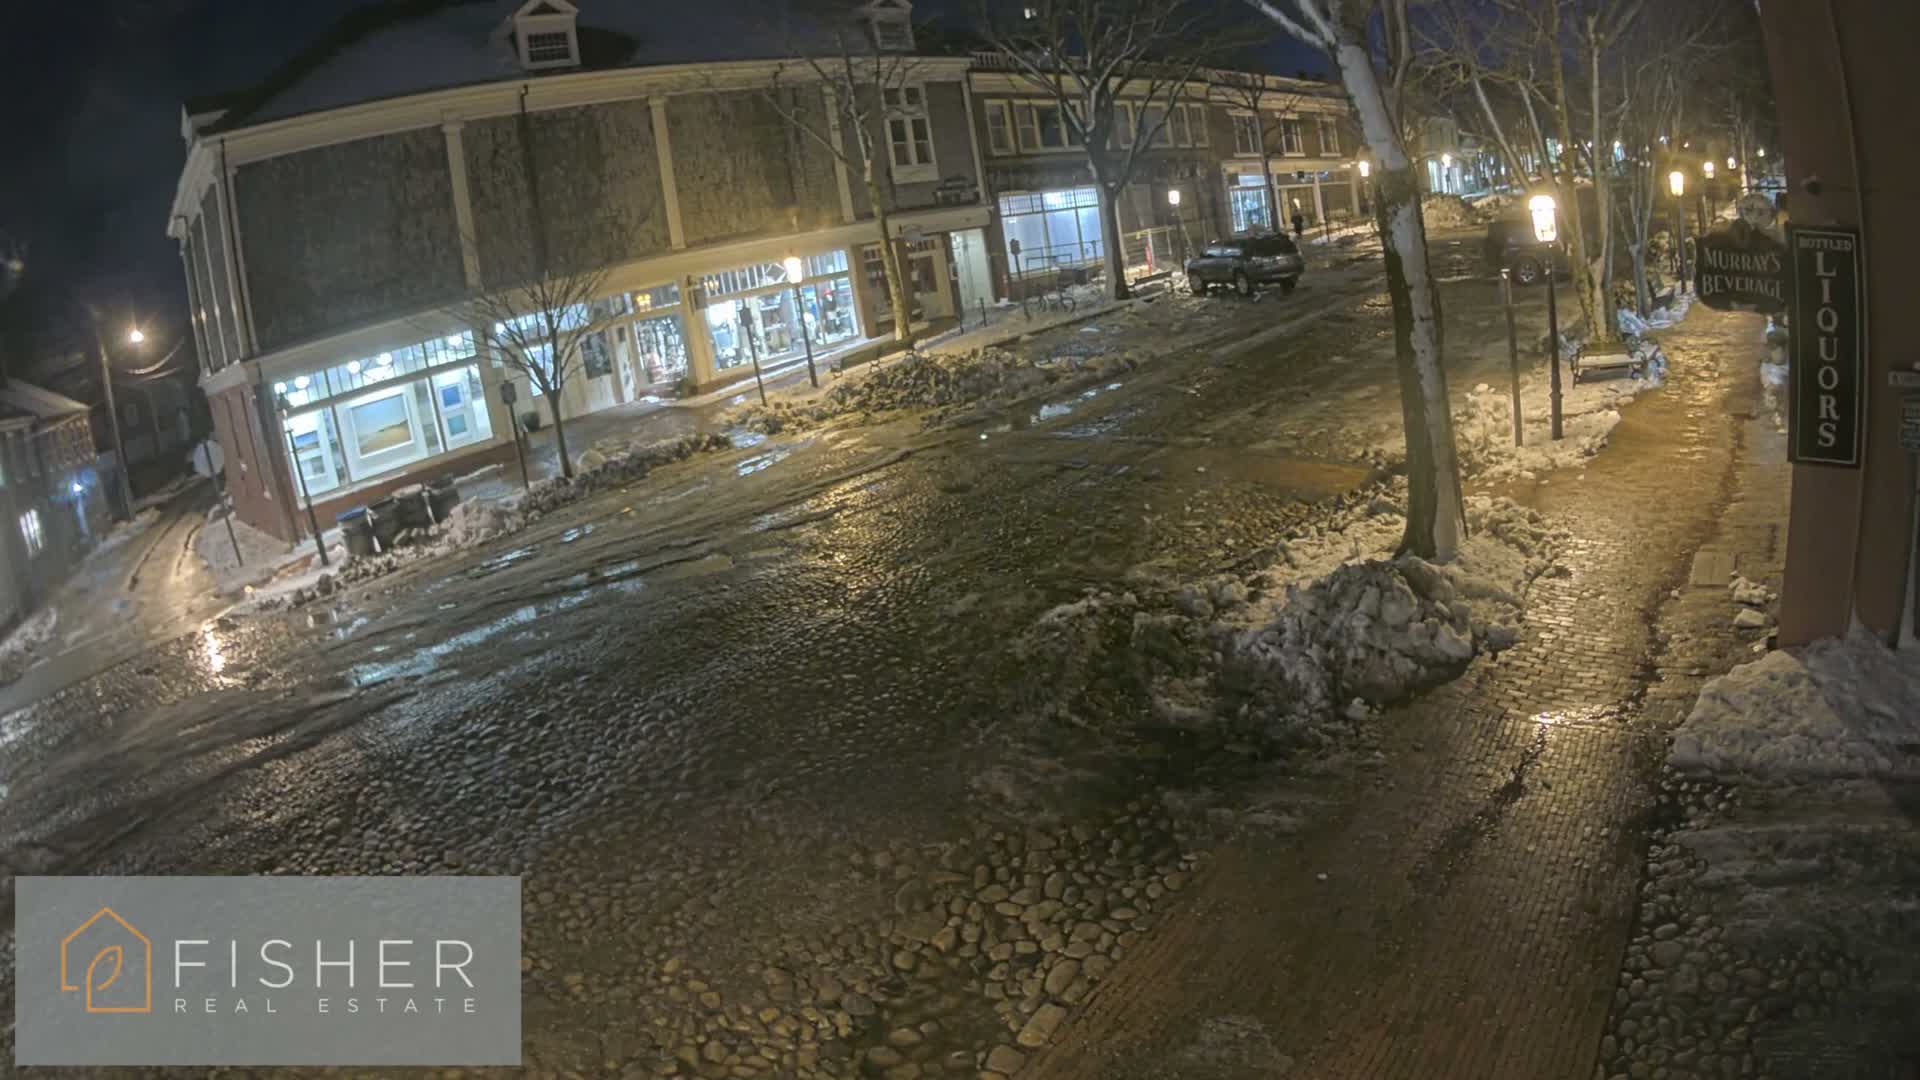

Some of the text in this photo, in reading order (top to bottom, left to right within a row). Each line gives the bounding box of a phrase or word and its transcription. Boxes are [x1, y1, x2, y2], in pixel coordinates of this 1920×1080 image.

[1799, 238, 1852, 251] BOTTLED
[1703, 248, 1781, 273] MURRAY'S
[1702, 277, 1784, 300] BEVERAGE
[1815, 252, 1840, 447] LIQUORS
